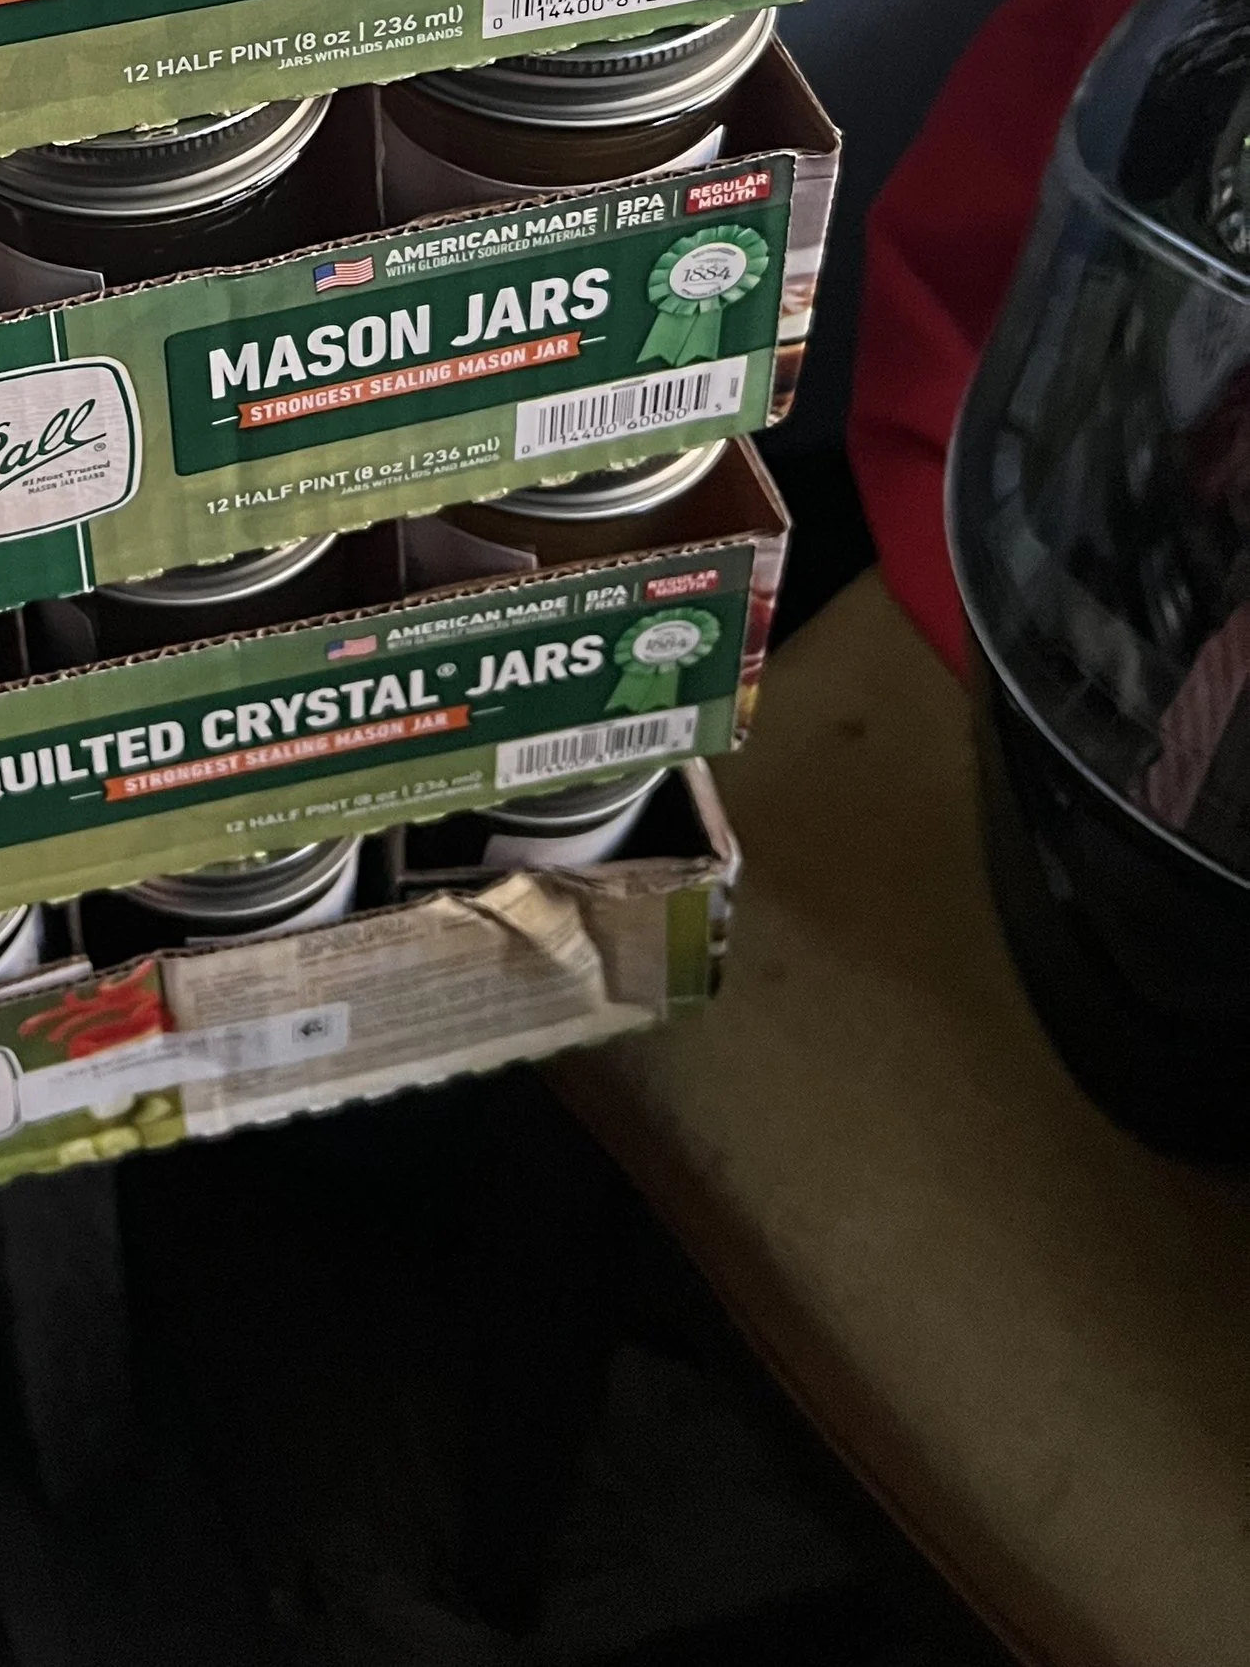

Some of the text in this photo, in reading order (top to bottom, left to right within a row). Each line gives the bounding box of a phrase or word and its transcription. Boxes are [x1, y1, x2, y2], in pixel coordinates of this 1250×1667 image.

[493, 17, 503, 30] 0
[123, 4, 464, 84] 12 HALF PINT (8 oz 236 ml)
[277, 26, 463, 71] JARS WITH LIDS AND BANDS
[617, 193, 666, 216] BPA
[688, 173, 769, 200] REGULAR
[698, 189, 757, 210] MOUTH
[384, 206, 598, 266] AMERICAN MADE
[615, 209, 665, 230] FREE
[386, 225, 597, 278] WITH GLOBALLY SOURCED MATERIALS
[681, 264, 732, 283] 1884
[207, 267, 610, 401] MASON JARS
[249, 338, 570, 424] STRONGEST SEALING MASON JAR
[560, 422, 617, 445] 14400
[627, 408, 687, 430] 60000
[206, 436, 501, 515] 12 HALF PINT (8 oz 236 ml)
[586, 584, 629, 604] BPA
[646, 569, 719, 590] REGULAR
[387, 609, 501, 642] AMERICAN
[506, 595, 569, 618] MADE
[584, 596, 628, 613] FREE
[465, 634, 606, 699] JARS
[124, 712, 450, 794] STRONGEST SEALING MASON JAR
[226, 819, 248, 834] 12
[250, 806, 300, 829] HALF
[306, 796, 351, 817] PINT
